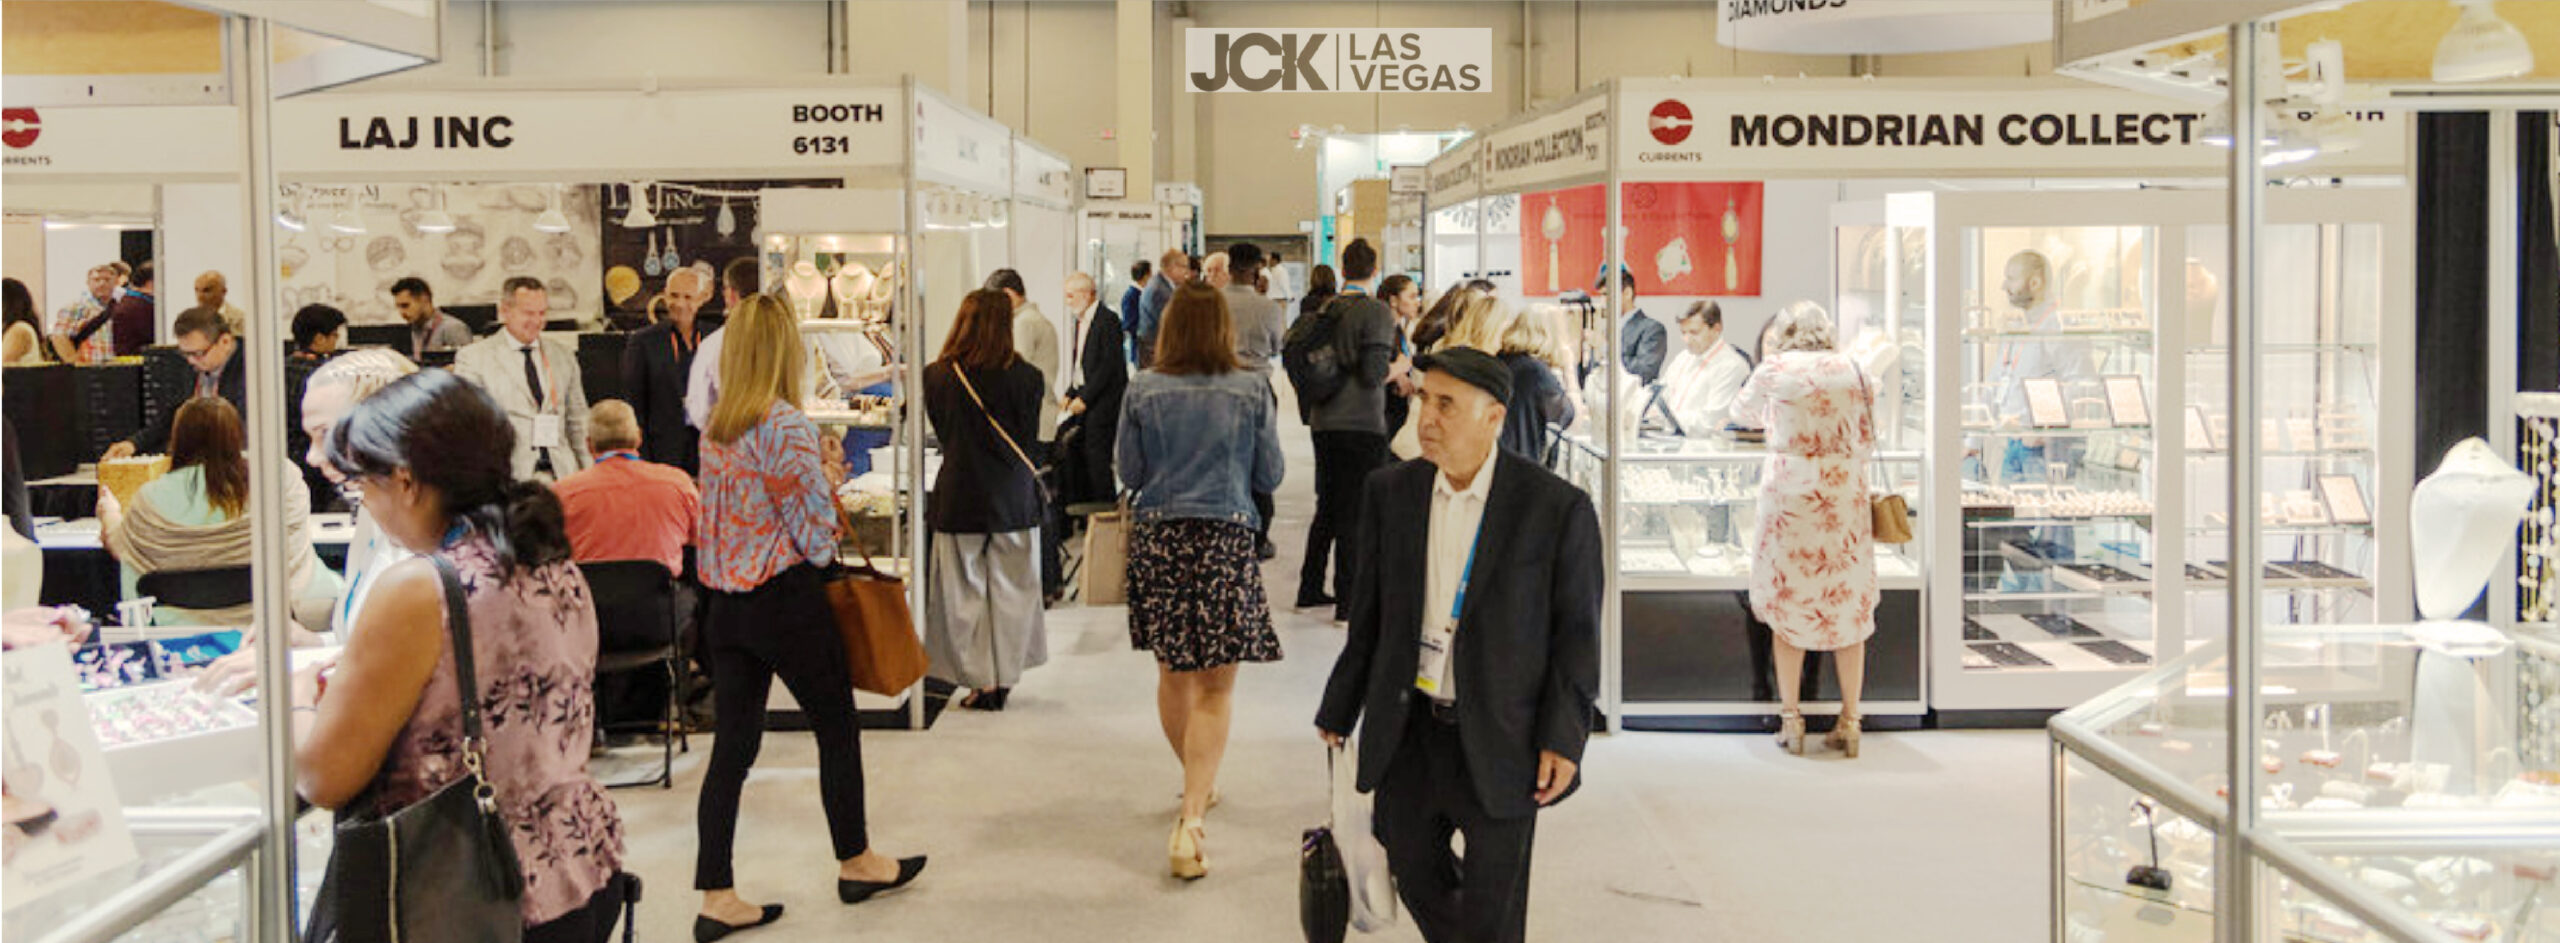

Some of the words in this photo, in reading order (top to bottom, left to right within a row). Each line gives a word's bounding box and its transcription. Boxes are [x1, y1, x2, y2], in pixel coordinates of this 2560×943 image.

[792, 104, 883, 123] BOOTH
[339, 116, 419, 150] LAJ
[433, 115, 514, 149] INC
[1730, 114, 1984, 147] MONDRIAN
[1997, 114, 2206, 146] COLLECT
[792, 135, 849, 155] 6131
[1638, 152, 1703, 163] CURRENTS
